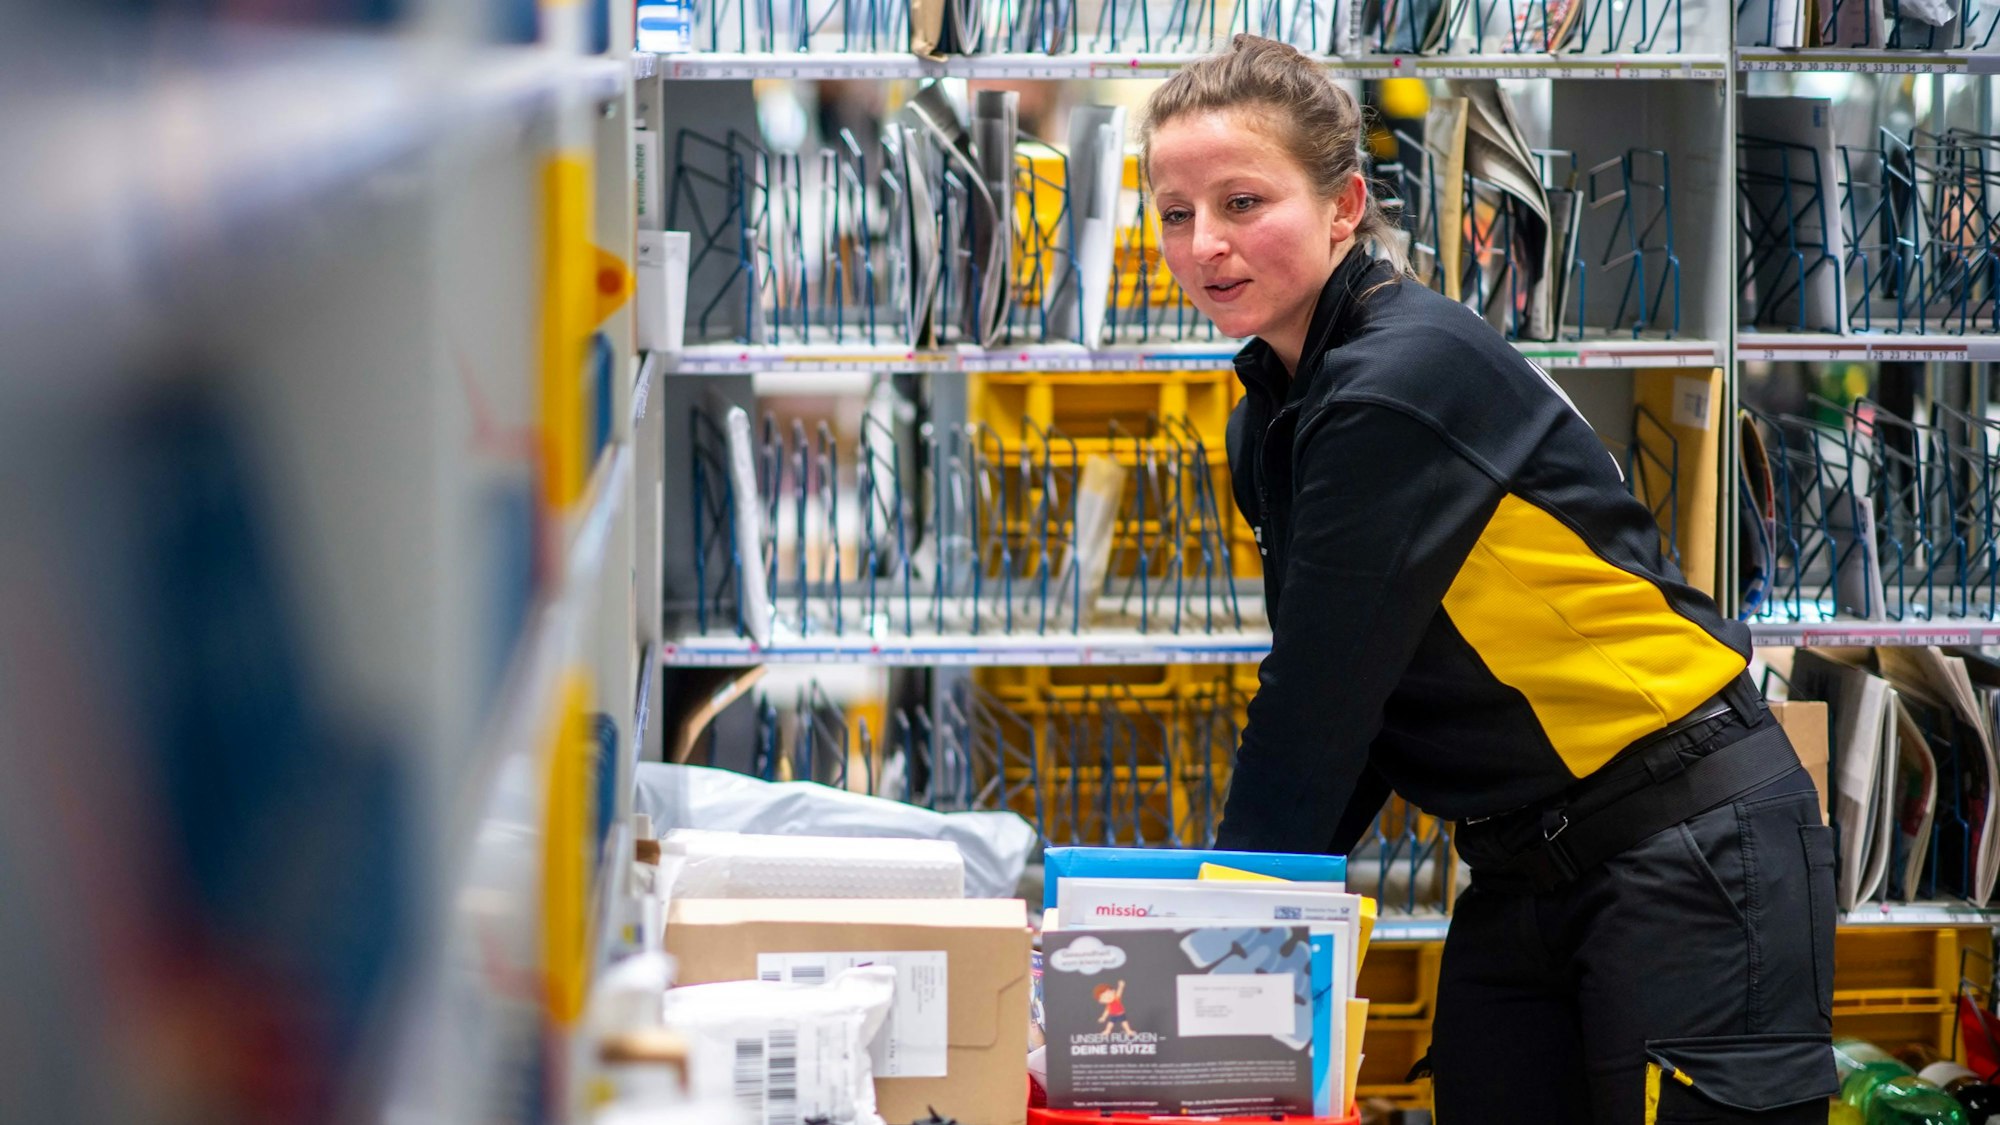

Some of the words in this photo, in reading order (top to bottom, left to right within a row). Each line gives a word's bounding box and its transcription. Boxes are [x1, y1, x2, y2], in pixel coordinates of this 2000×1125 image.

[1743, 62, 1753, 71] 26
[1759, 62, 1769, 71] 27
[1808, 62, 1819, 71] 30
[1825, 62, 1835, 71] 32
[1841, 62, 1851, 71] 37
[1857, 63, 1867, 72] 35
[1874, 63, 1884, 72] 33
[1890, 63, 1900, 72] 31
[1906, 63, 1916, 72] 34
[1922, 63, 1932, 72] 36
[1946, 64, 1957, 73] 38
[1829, 349, 1839, 358] 27
[1874, 351, 1884, 360] 25
[1890, 351, 1900, 360] 23
[1907, 351, 1916, 360] 21
[1923, 351, 1932, 360] 19
[1939, 351, 1948, 360] 17
[1955, 351, 1965, 360] 15
[1942, 635, 1951, 644] 14
[1958, 635, 1967, 644] 12
[1096, 903, 1147, 917] missio
[1071, 1033, 1108, 1044] UNSER
[1111, 1031, 1157, 1043] RÜCKEN
[1071, 1044, 1108, 1056] DEINE
[1110, 1042, 1157, 1055] STÜTZE
